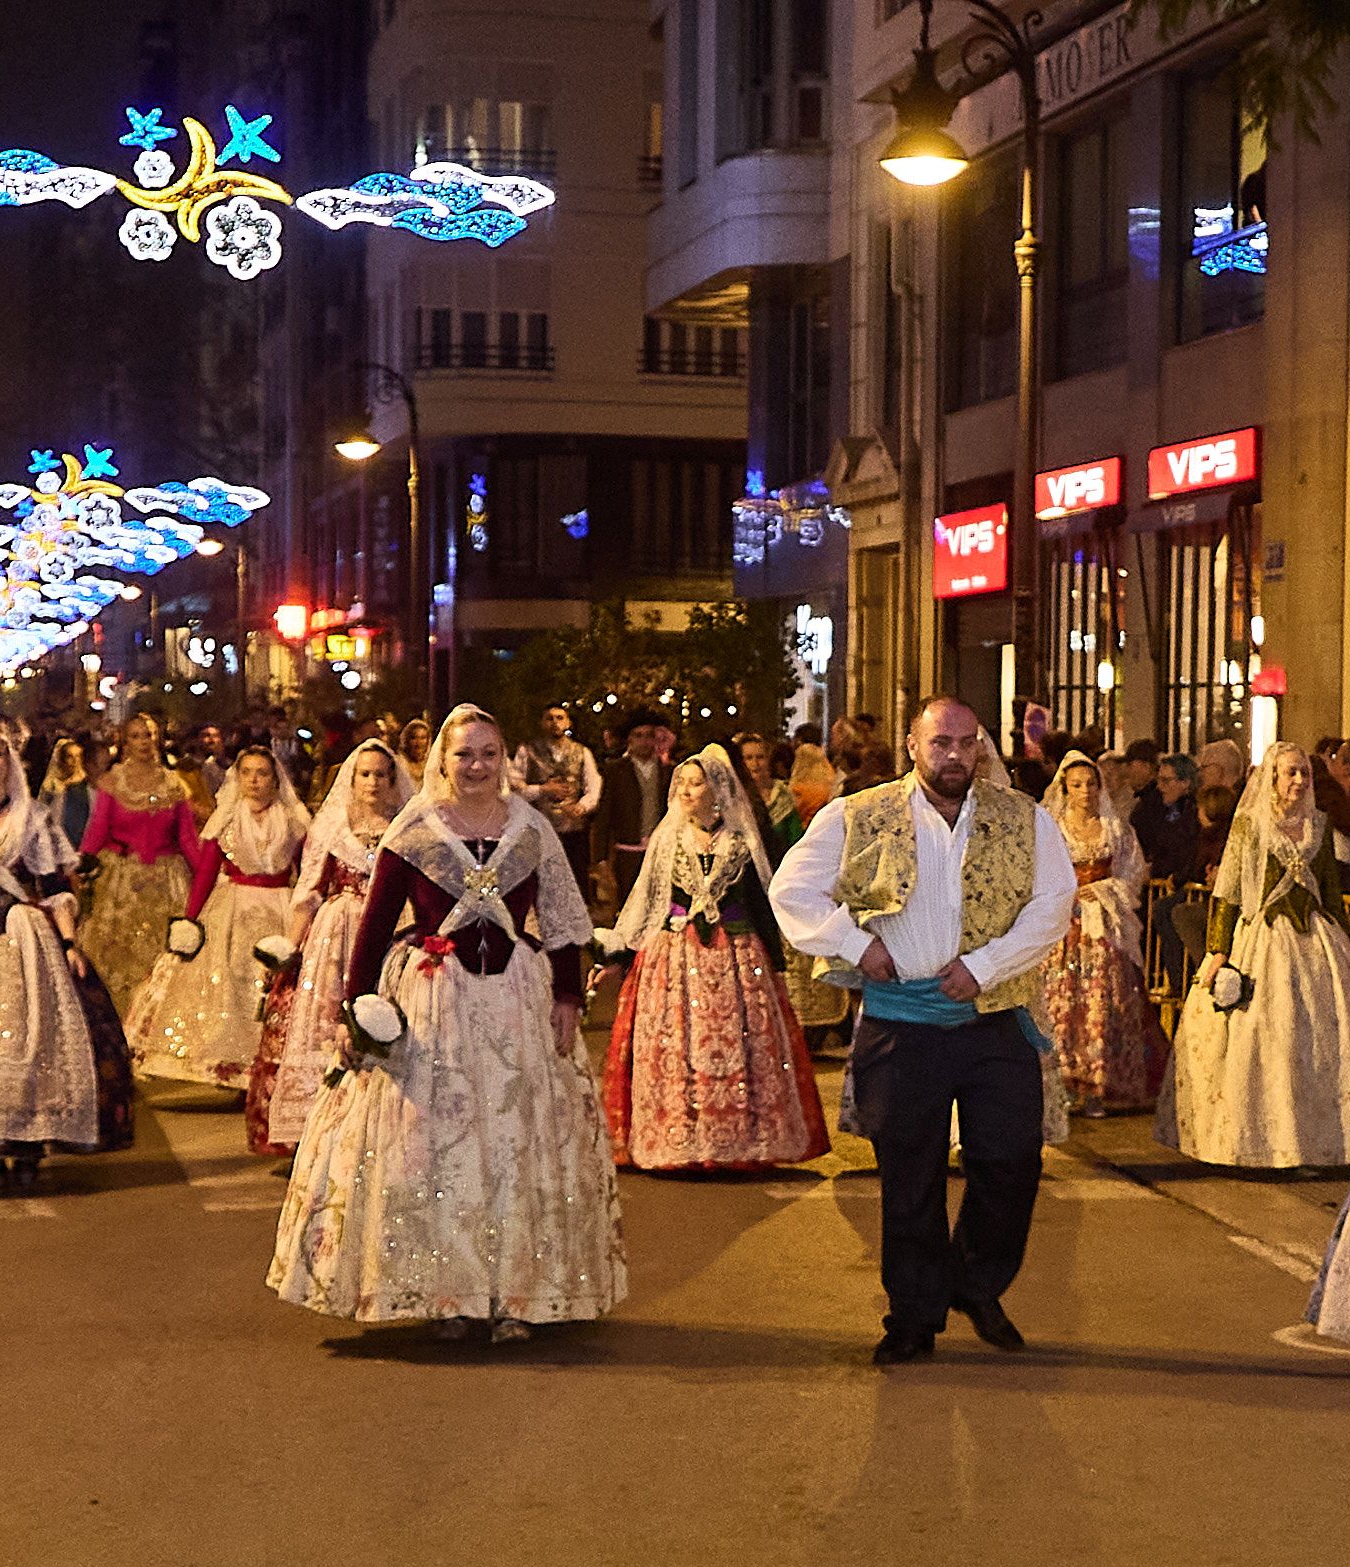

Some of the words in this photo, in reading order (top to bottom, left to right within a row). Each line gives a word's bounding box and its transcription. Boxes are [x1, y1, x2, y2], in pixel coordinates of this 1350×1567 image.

[1167, 438, 1236, 486] VIPS
[1047, 466, 1105, 508] VIPS
[946, 519, 994, 557] VIPS
